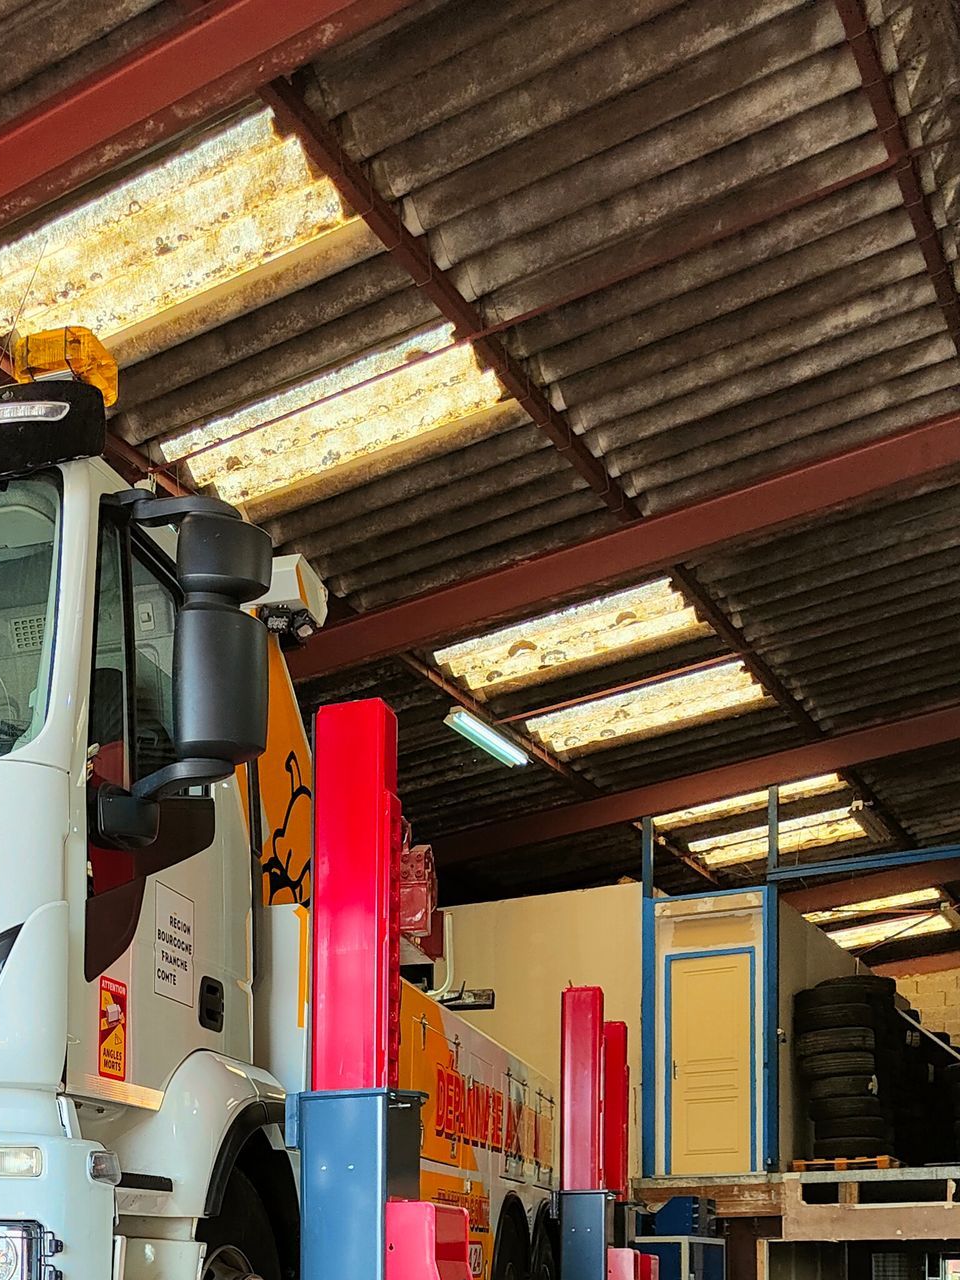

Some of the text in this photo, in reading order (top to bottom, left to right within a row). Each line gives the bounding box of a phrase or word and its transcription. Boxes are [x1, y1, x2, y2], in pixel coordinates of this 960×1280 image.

[161, 949, 188, 972] FRANCHE
[101, 979, 126, 996] ATTENTION
[102, 1047, 122, 1062] ANGLES
[103, 1058, 121, 1072] MORTS
